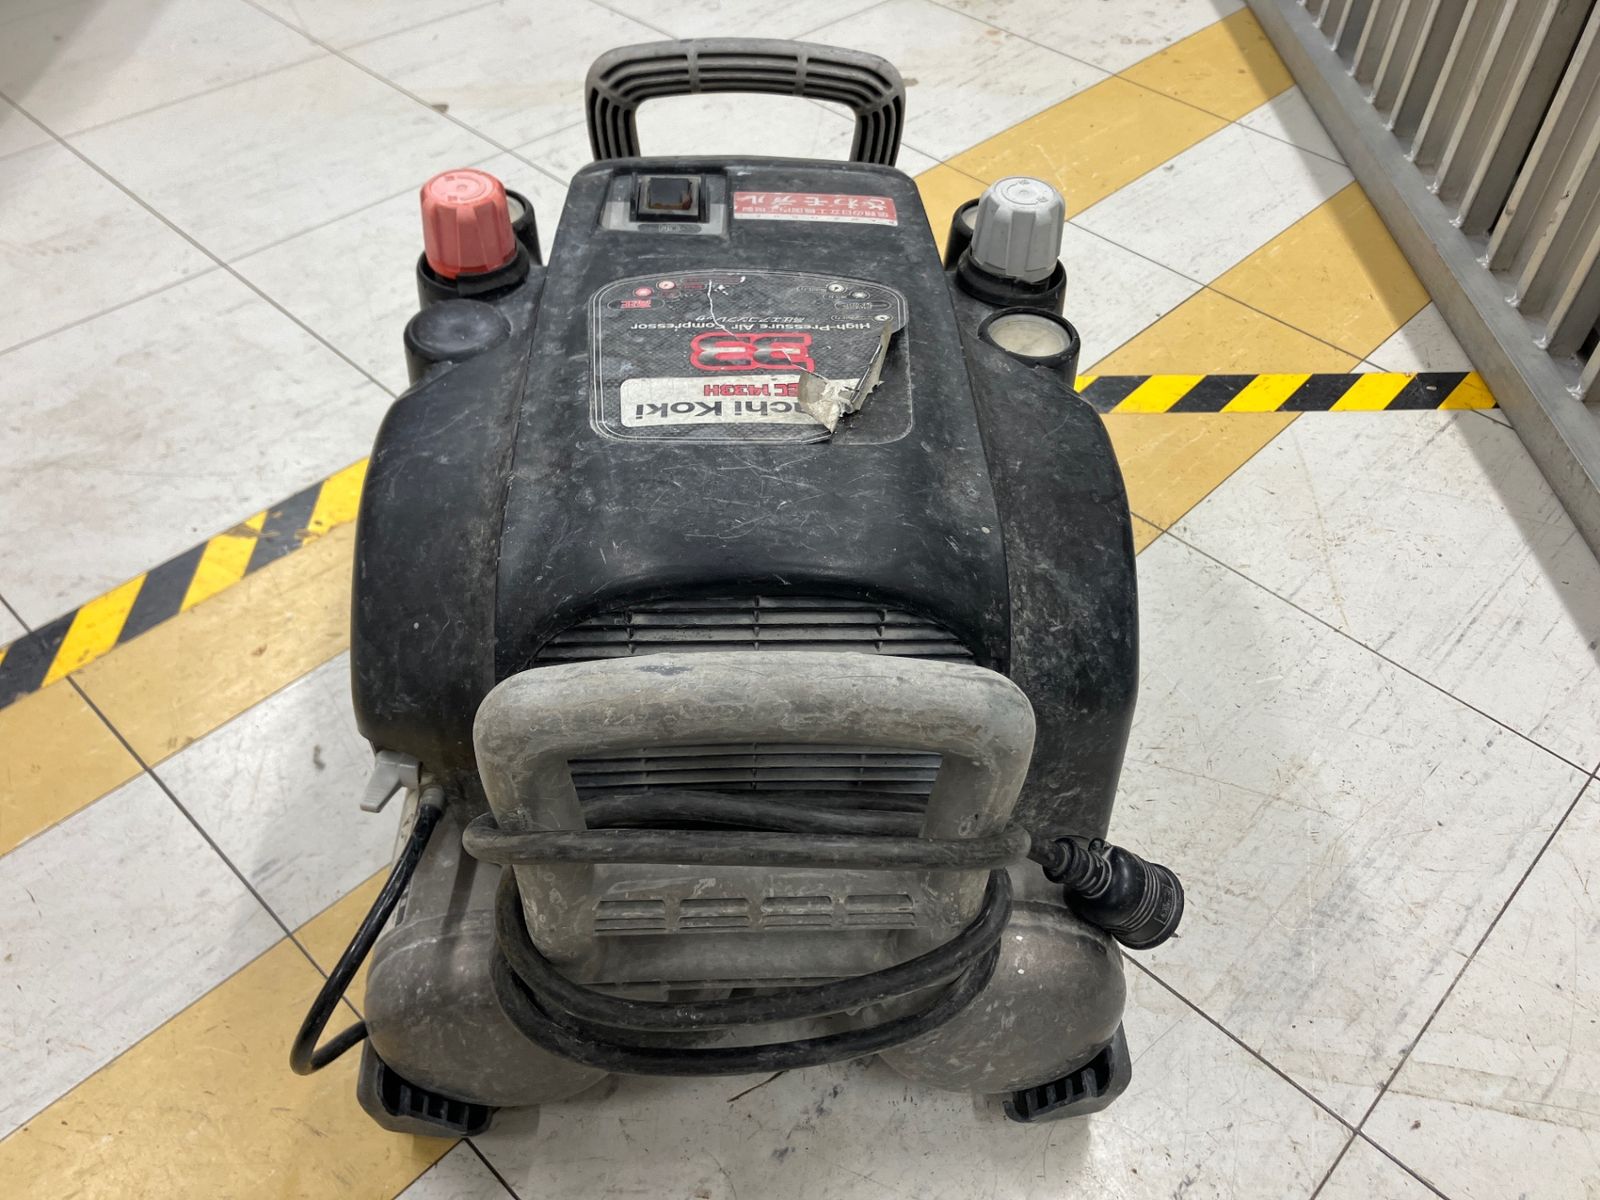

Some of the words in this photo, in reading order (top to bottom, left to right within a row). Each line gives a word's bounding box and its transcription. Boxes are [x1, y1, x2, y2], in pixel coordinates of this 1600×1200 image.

[730, 322, 755, 331] Air
[759, 321, 870, 331] High-Pressure
[635, 400, 722, 419] Koki
